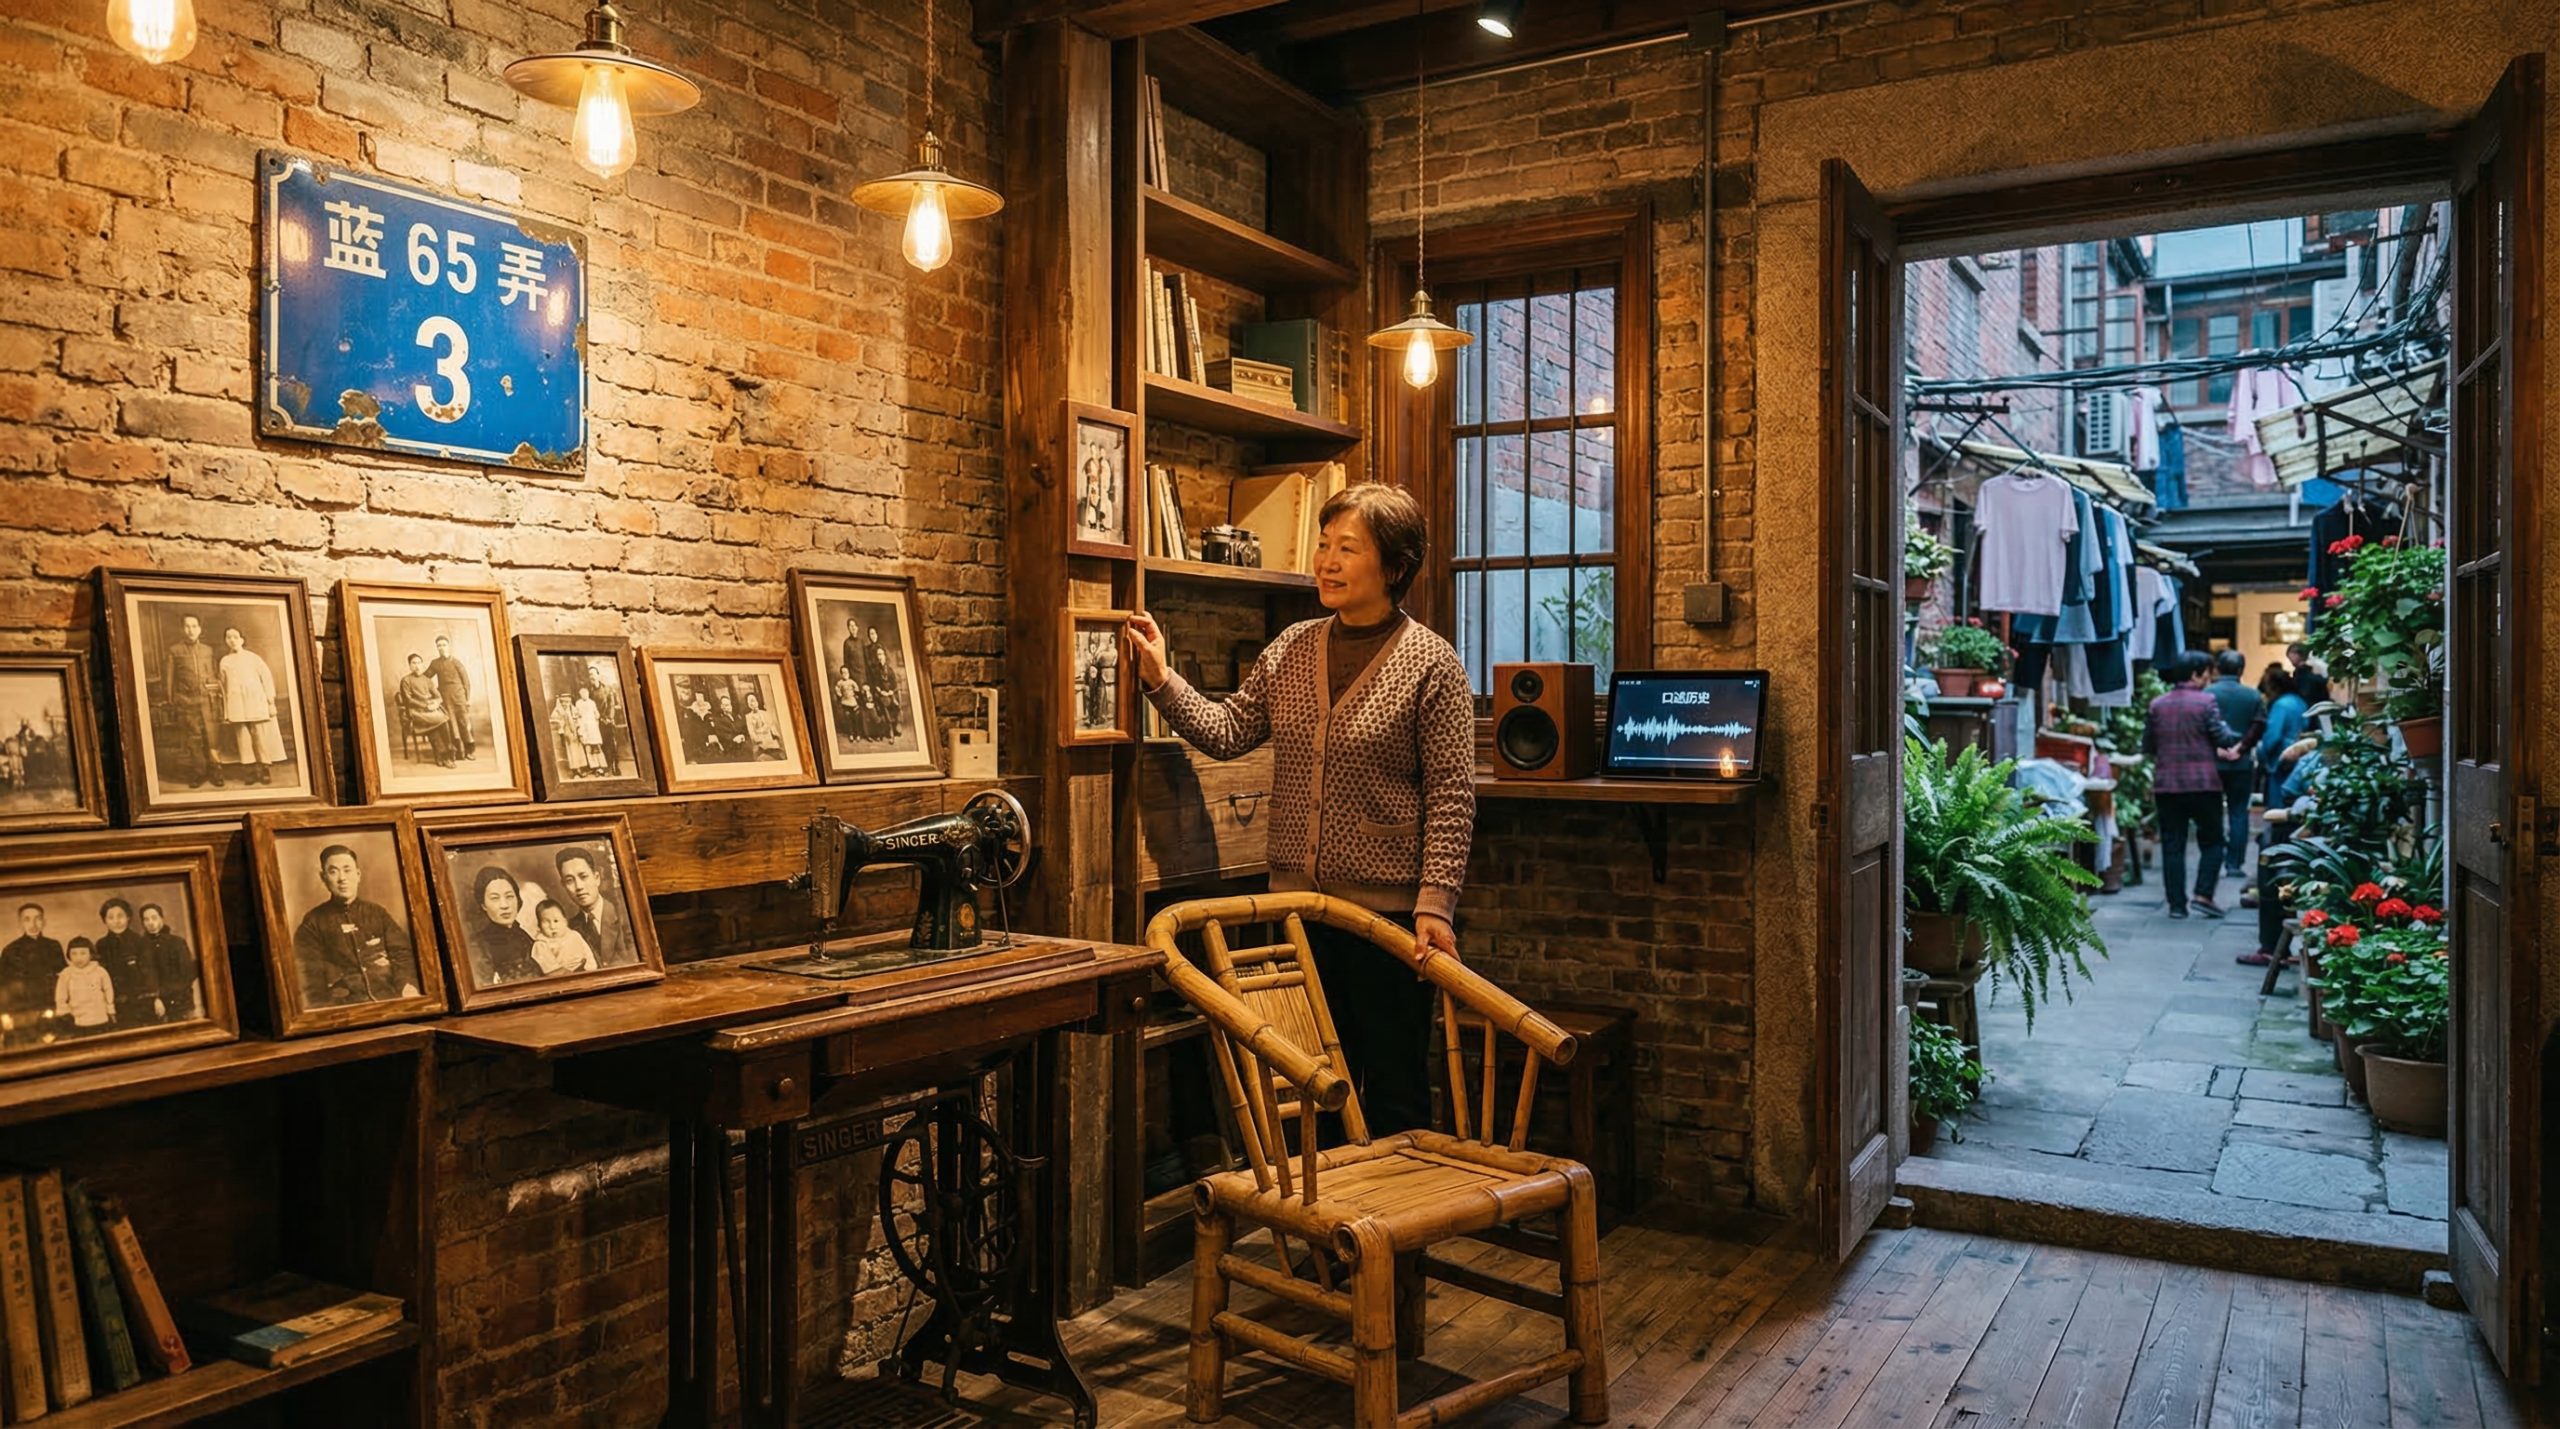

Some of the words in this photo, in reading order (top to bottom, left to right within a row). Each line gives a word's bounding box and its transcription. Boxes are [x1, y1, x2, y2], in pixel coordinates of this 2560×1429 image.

[323, 200, 387, 279] 蓝
[407, 222, 477, 294] 65
[497, 241, 549, 311] 弄
[414, 315, 471, 424] 3
[804, 1120, 879, 1157] SINGER
